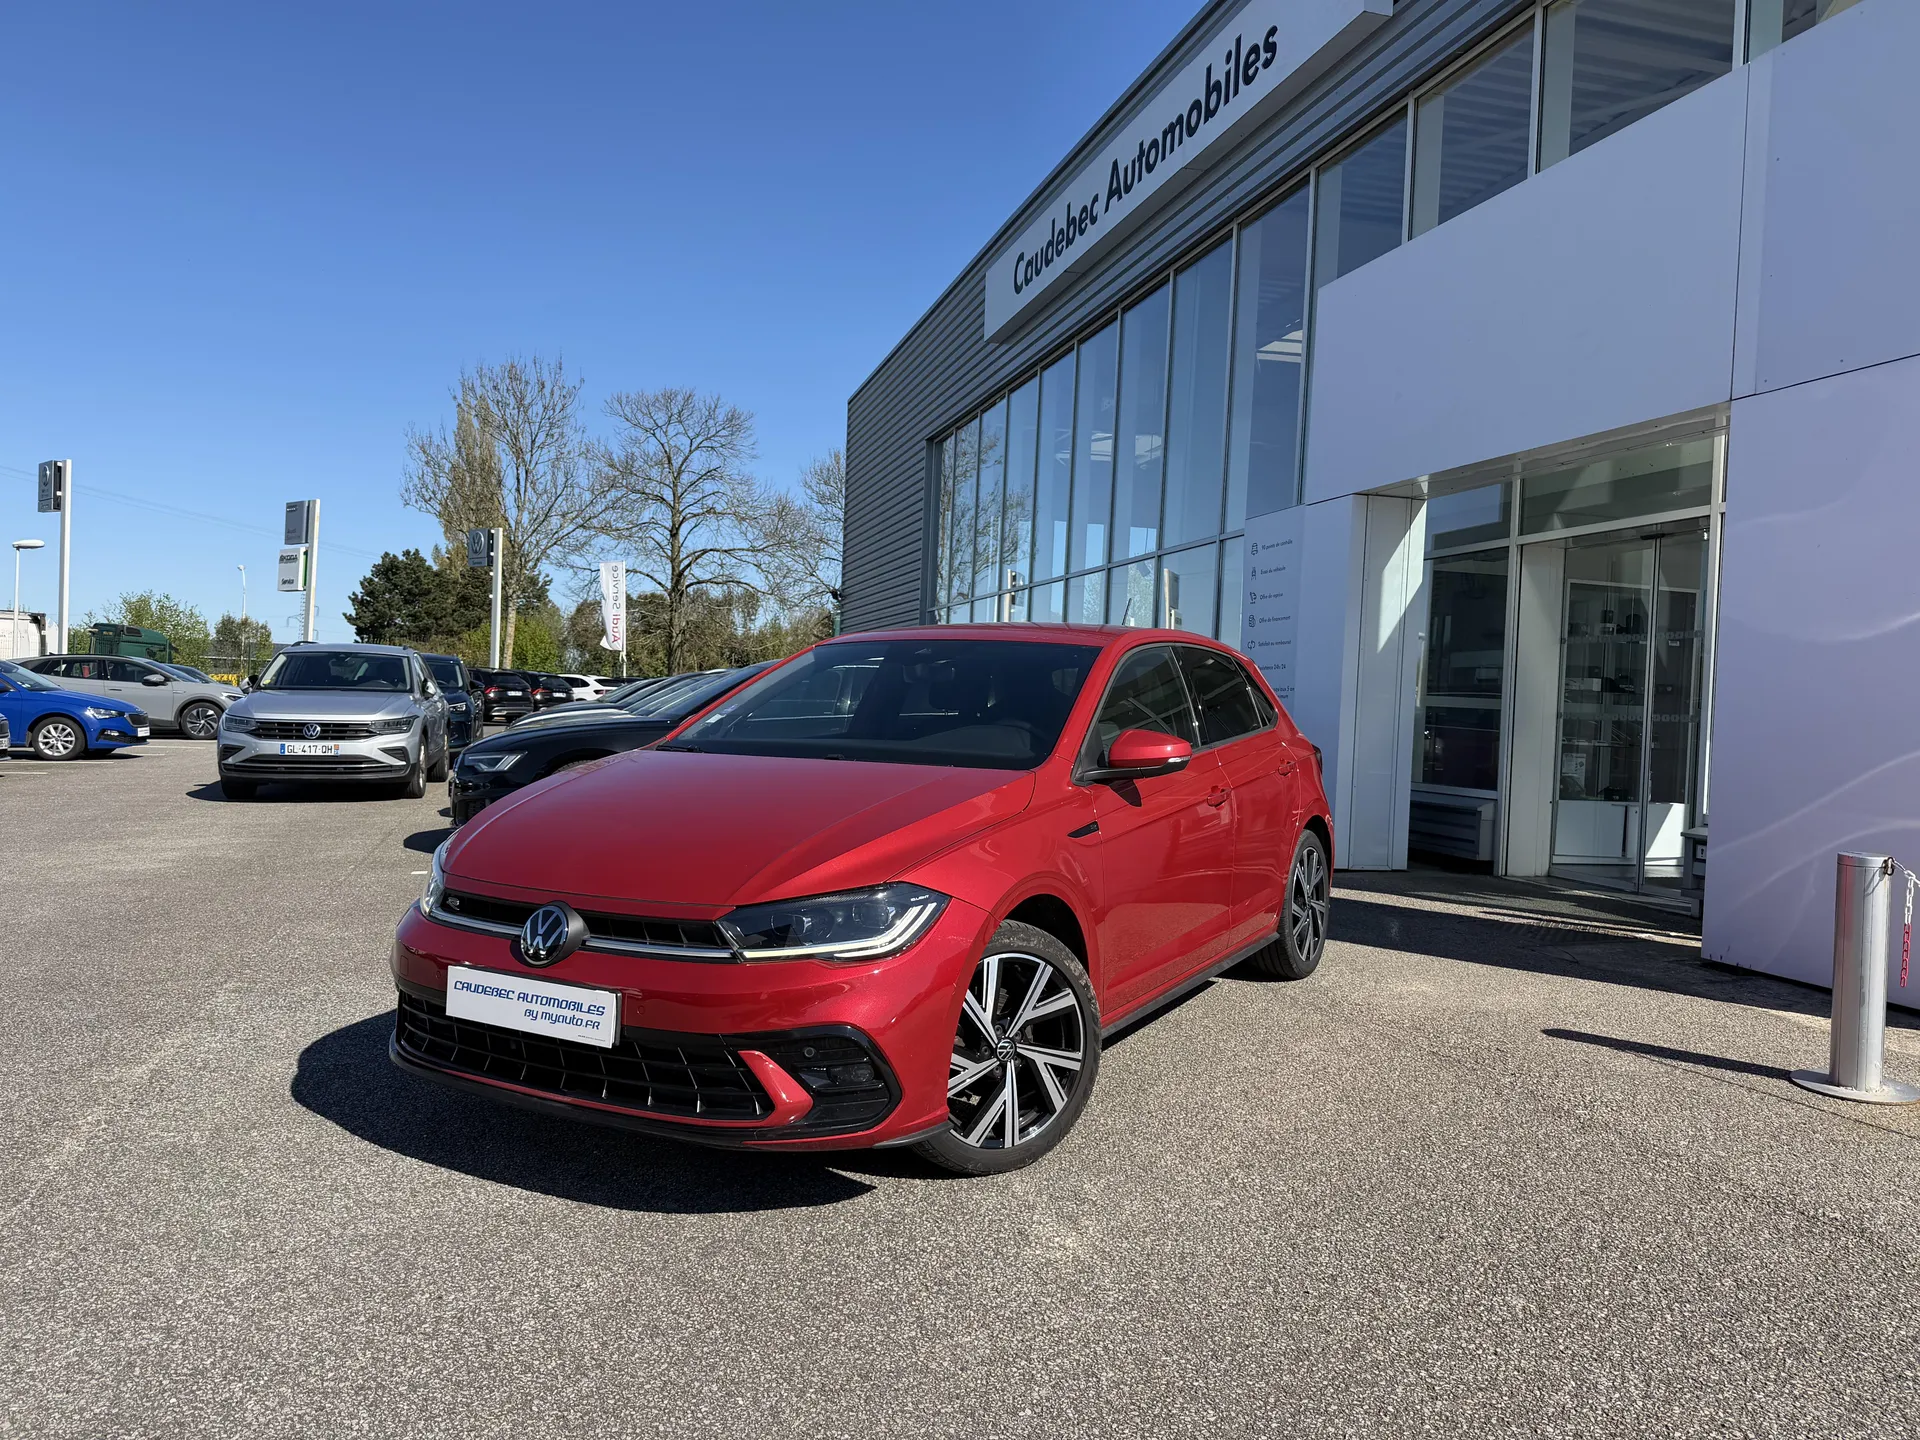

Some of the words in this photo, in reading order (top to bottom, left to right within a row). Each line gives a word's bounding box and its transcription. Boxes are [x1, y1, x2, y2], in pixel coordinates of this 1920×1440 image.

[1012, 192, 1100, 296] Caudebec
[1103, 24, 1280, 215] Automobiles
[453, 980, 515, 1001] CAUDEBEC
[516, 991, 606, 1017] AUTOMOBILES
